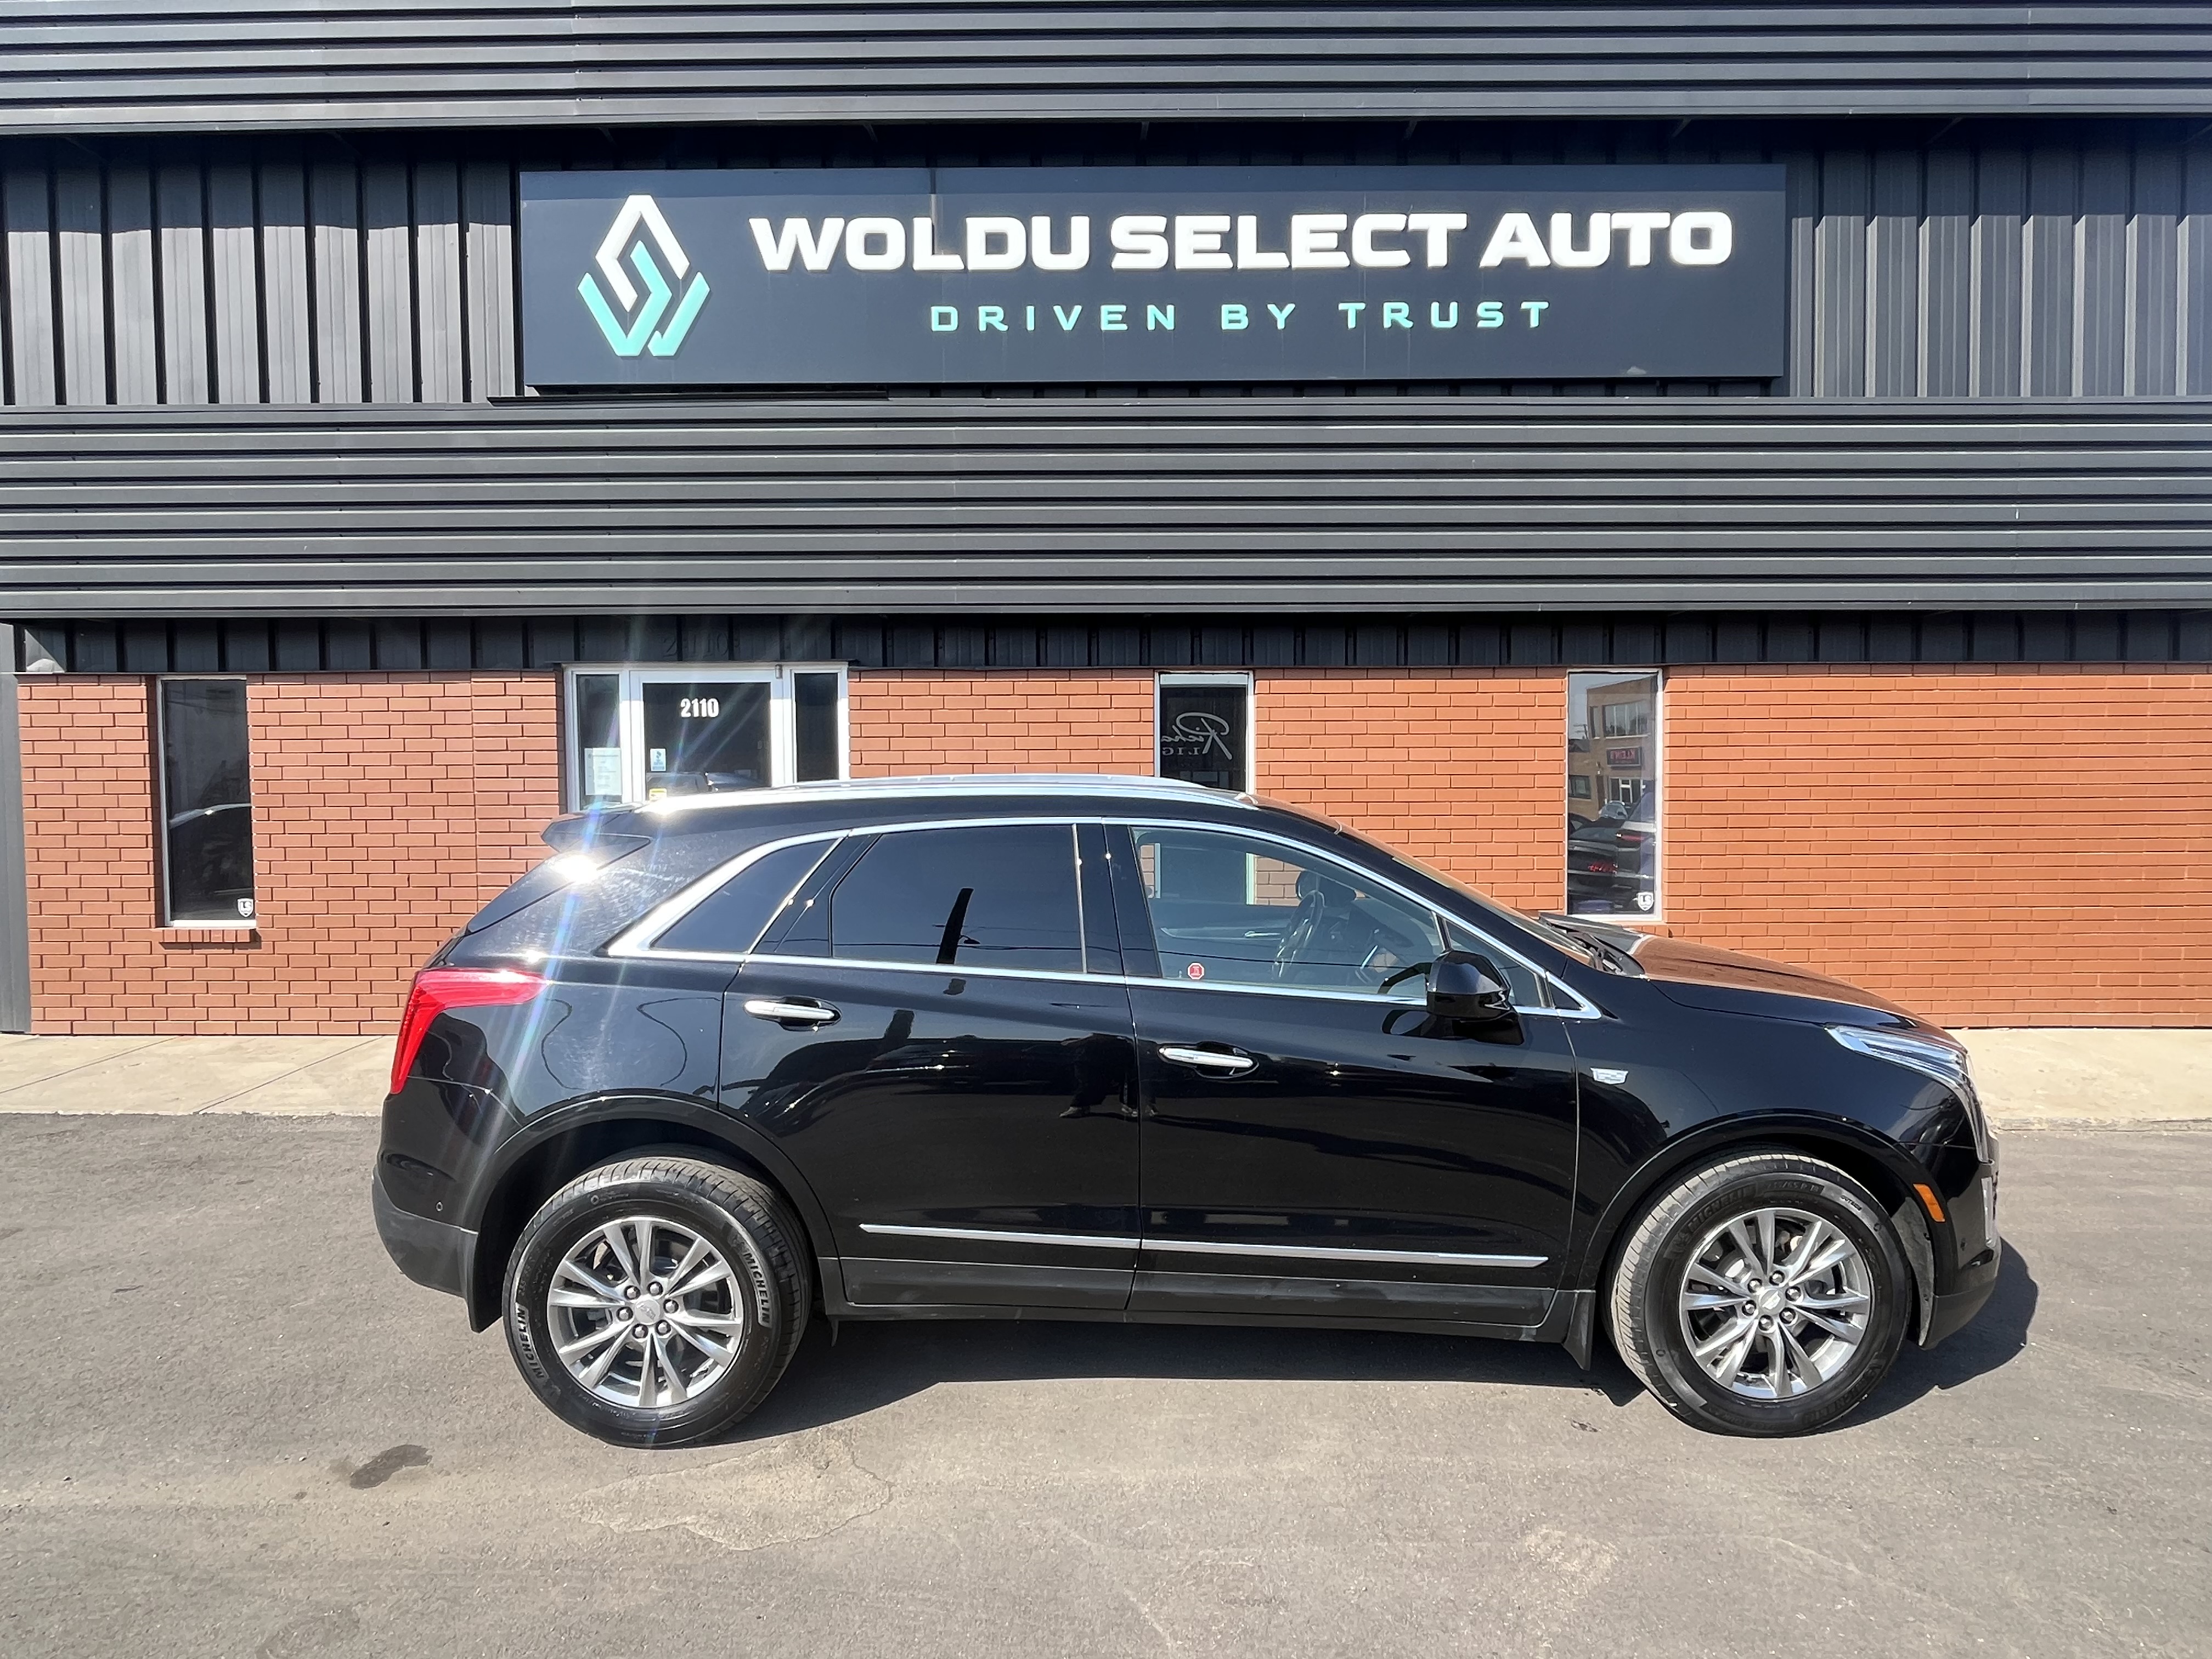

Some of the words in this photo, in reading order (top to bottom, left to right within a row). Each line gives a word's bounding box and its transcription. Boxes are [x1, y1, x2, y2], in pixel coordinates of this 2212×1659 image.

[749, 216, 1089, 272] WOLDU
[1111, 213, 1467, 270] SELECT
[1479, 212, 1733, 268] AUTO
[930, 304, 1175, 332] DRIVEN
[1221, 303, 1296, 330] BY
[1338, 301, 1549, 330] TRUST
[680, 698, 719, 718] 2110
[240, 902, 251, 911] LS
[1640, 895, 1651, 905] LS
[743, 1252, 771, 1324] MICHELIN
[516, 1307, 546, 1379] MICHELIN
